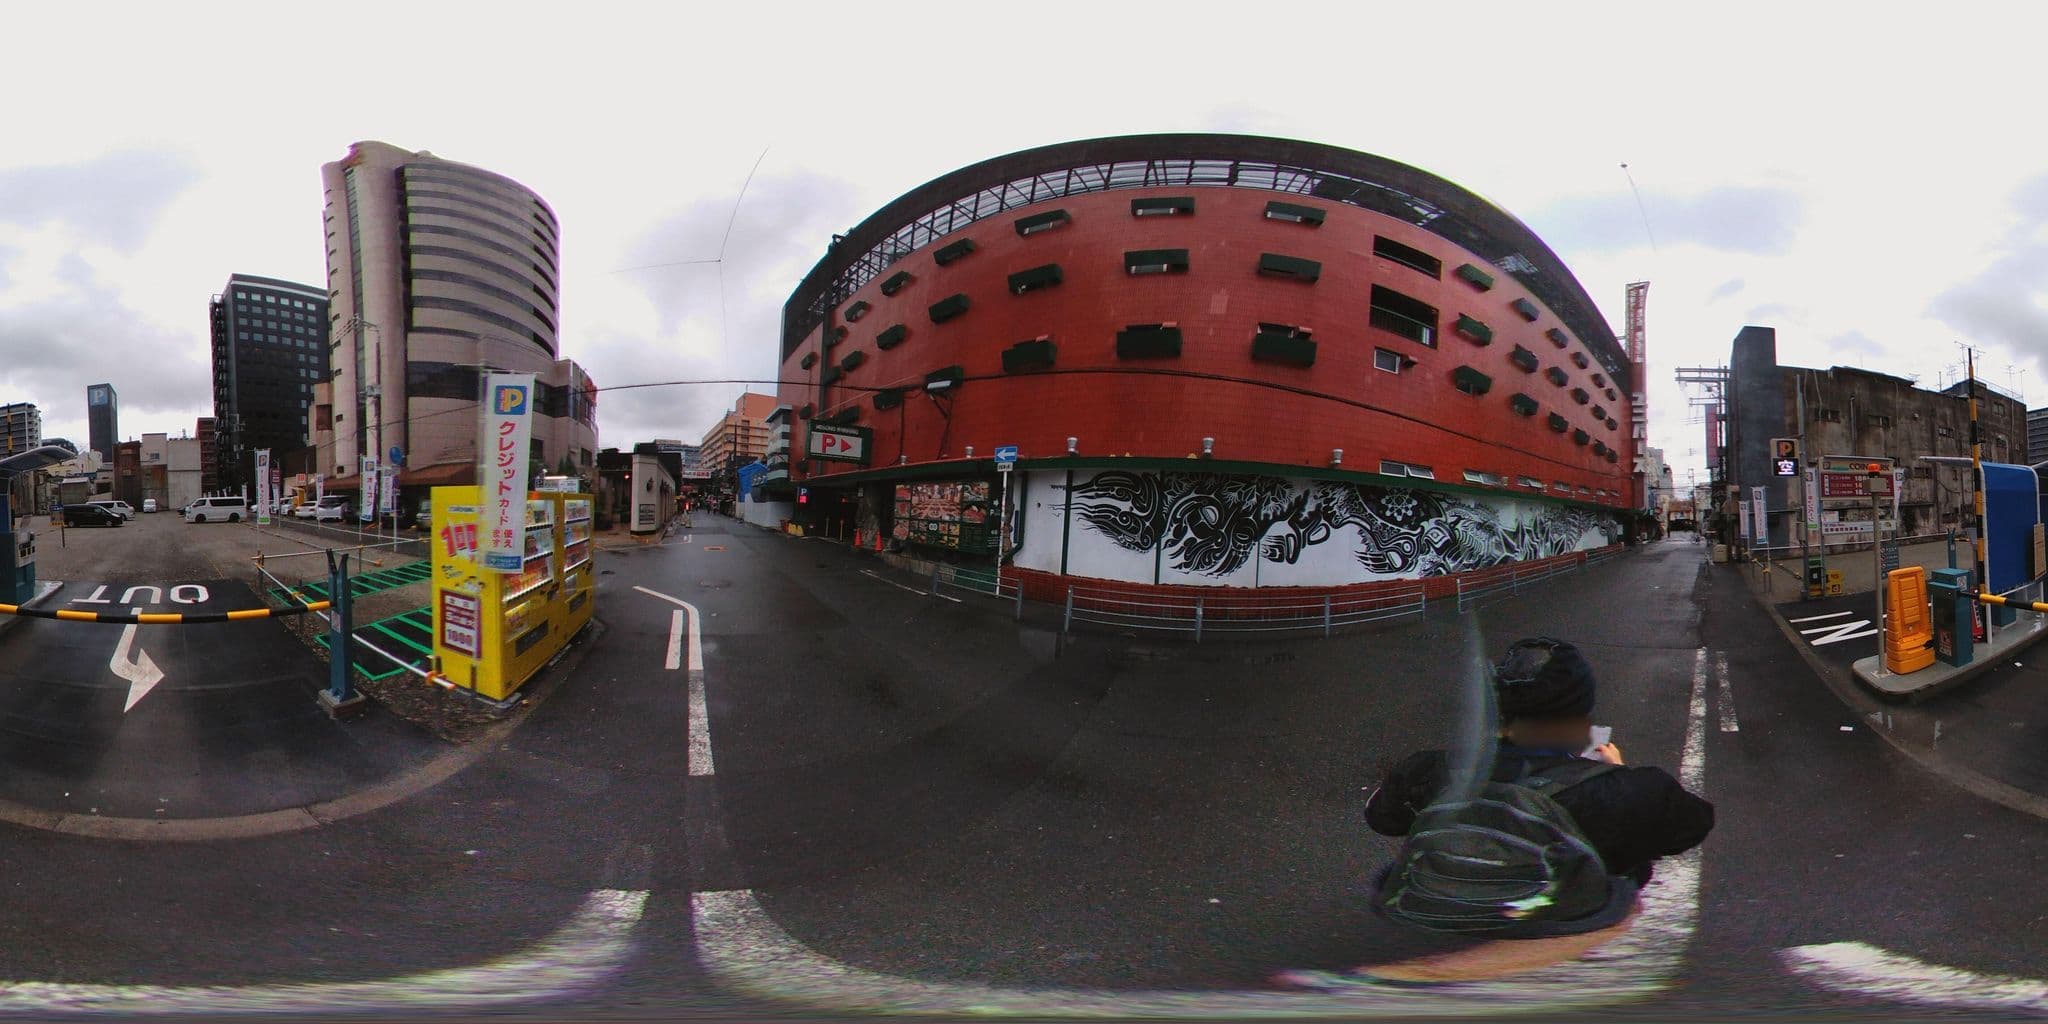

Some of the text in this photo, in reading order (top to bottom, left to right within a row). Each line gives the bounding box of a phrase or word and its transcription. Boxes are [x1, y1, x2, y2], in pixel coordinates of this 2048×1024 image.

[822, 433, 836, 453] P
[498, 421, 516, 526] クレジットカード
[1777, 459, 1795, 475] 空
[72, 584, 209, 604] OUT
